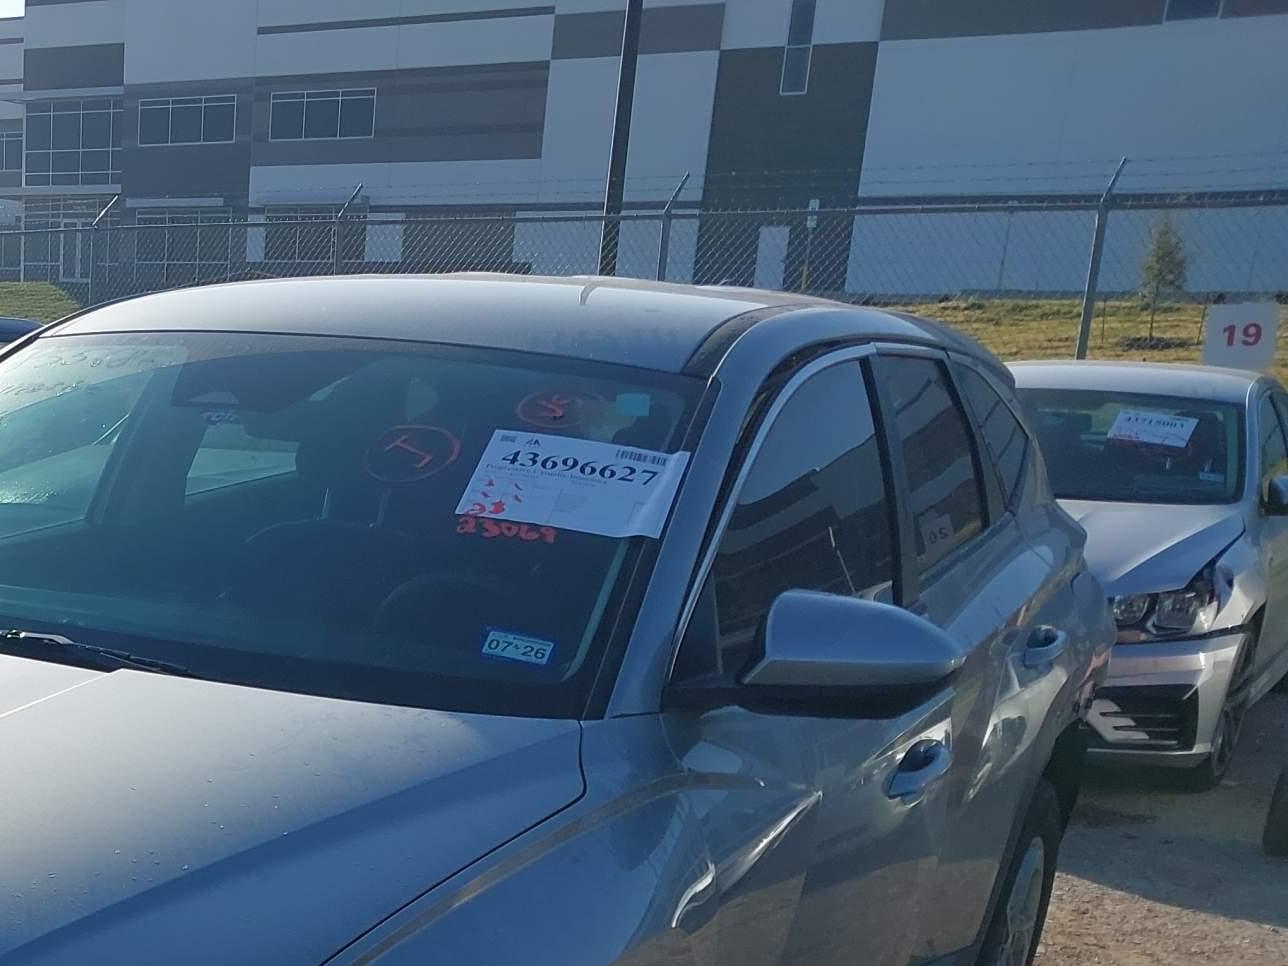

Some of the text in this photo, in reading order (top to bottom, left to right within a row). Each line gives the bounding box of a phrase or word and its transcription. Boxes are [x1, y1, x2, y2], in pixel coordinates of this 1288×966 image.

[1223, 322, 1263, 347] 19
[501, 449, 659, 486] 43696627
[487, 639, 547, 660] 07 26
